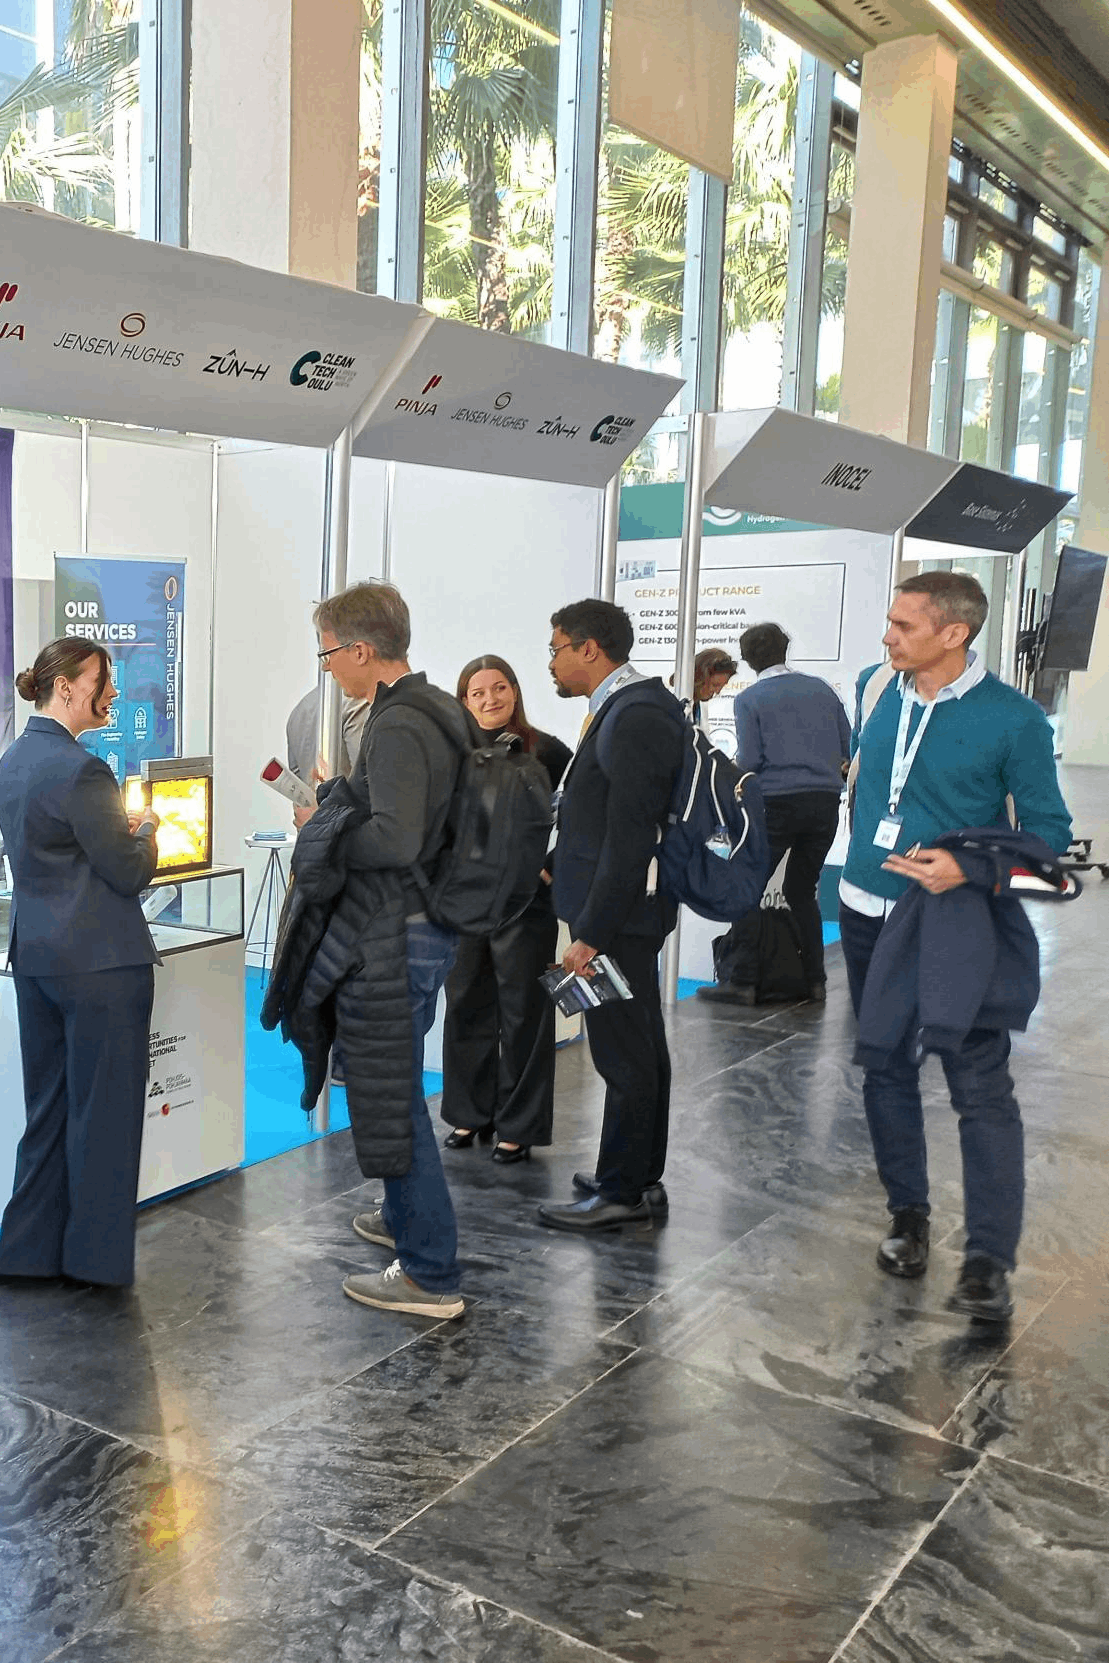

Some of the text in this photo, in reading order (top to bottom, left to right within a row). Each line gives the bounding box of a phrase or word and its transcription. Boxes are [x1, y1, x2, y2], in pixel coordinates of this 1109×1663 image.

[53, 332, 185, 368] JENSEN HUGHES
[322, 353, 356, 368] CLEAN
[312, 365, 338, 378] TECH
[307, 378, 333, 391] OULU
[394, 398, 438, 416] PINJA
[451, 408, 529, 430] JENSEN HUGHES
[821, 462, 872, 491] INOCEL
[634, 588, 666, 598] GEN-Z
[723, 585, 762, 596] RANGE
[64, 601, 99, 618] OUR
[639, 610, 664, 618] GEN-Z
[713, 608, 729, 616] few
[729, 607, 747, 616] kVA
[65, 624, 137, 640] SERVICES
[638, 637, 662, 645] GEN-Z
[166, 603, 176, 720] JENSEN HUGHES
